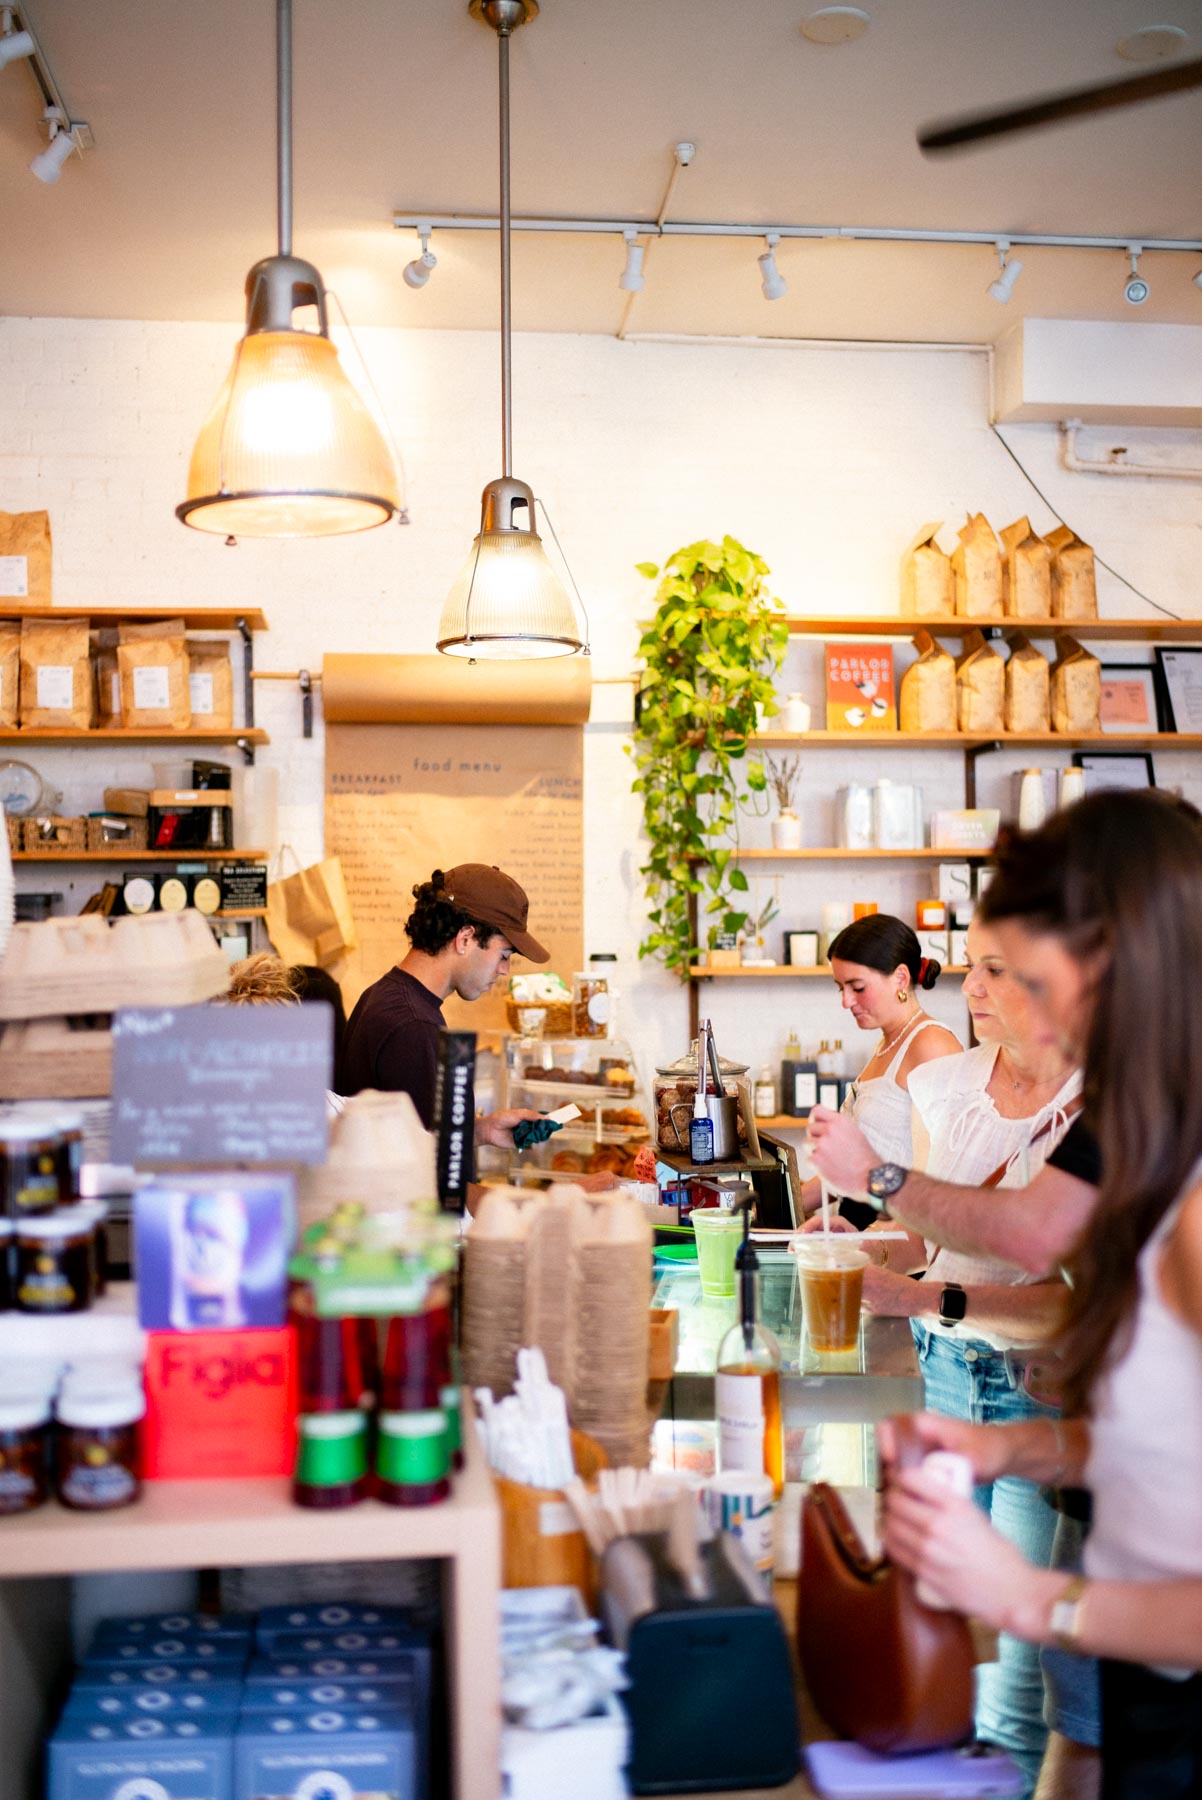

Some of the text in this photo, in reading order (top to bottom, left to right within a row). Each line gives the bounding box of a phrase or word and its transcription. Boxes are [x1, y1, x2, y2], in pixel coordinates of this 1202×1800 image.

[830, 657, 890, 672] PARLOR
[830, 670, 890, 683] COFFEE
[413, 757, 502, 773] food menu
[331, 773, 402, 784] BREAKFAST
[538, 776, 582, 788] LUNCH
[448, 1066, 468, 1189] PARLOR COFFEE
